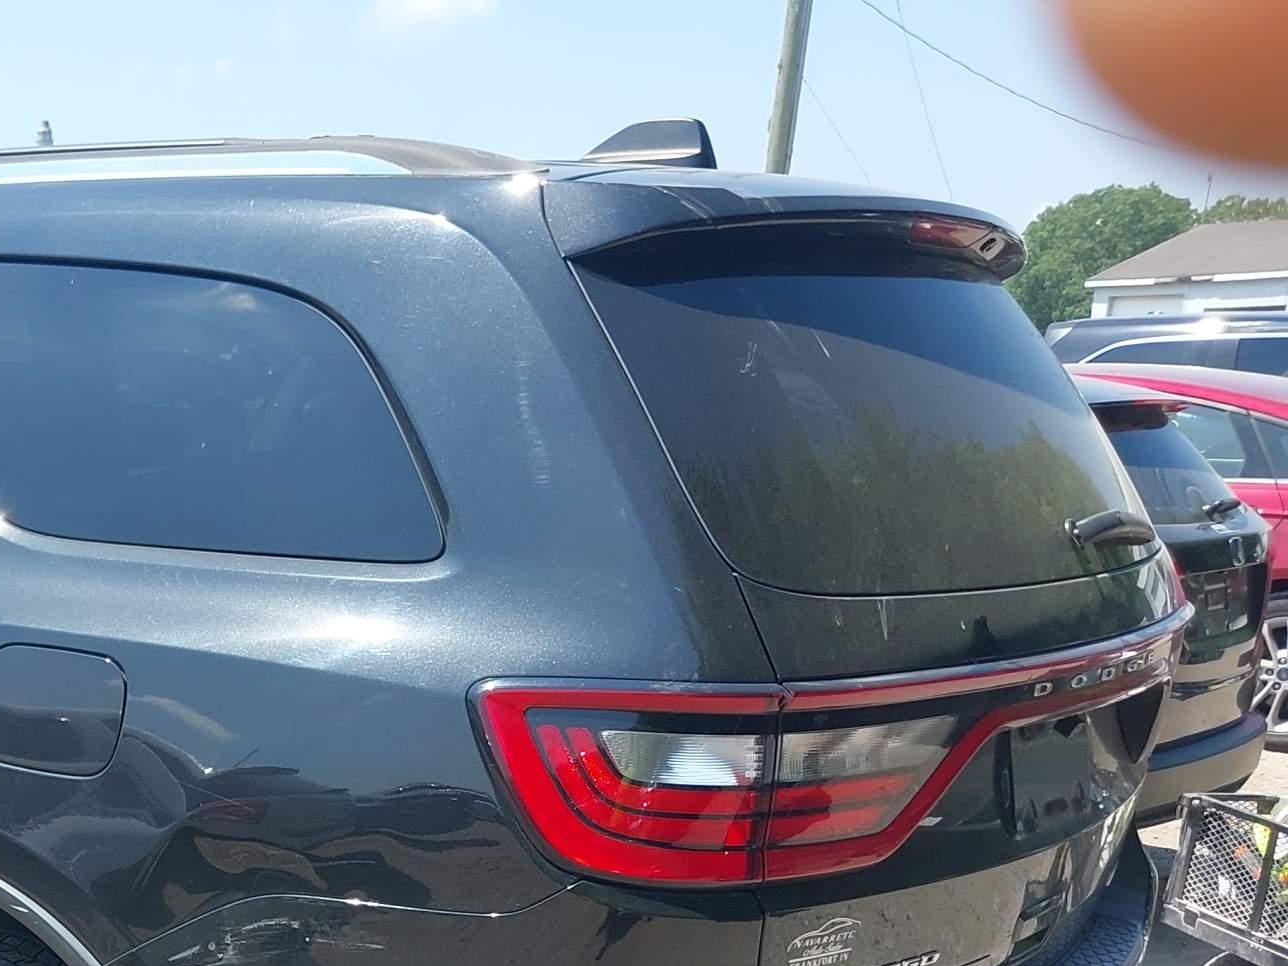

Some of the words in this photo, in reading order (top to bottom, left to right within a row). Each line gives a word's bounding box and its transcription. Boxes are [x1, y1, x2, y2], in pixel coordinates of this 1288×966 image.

[1033, 651, 1156, 697] DODGE
[793, 930, 856, 949] NAVARRETE
[839, 952, 849, 962] IN
